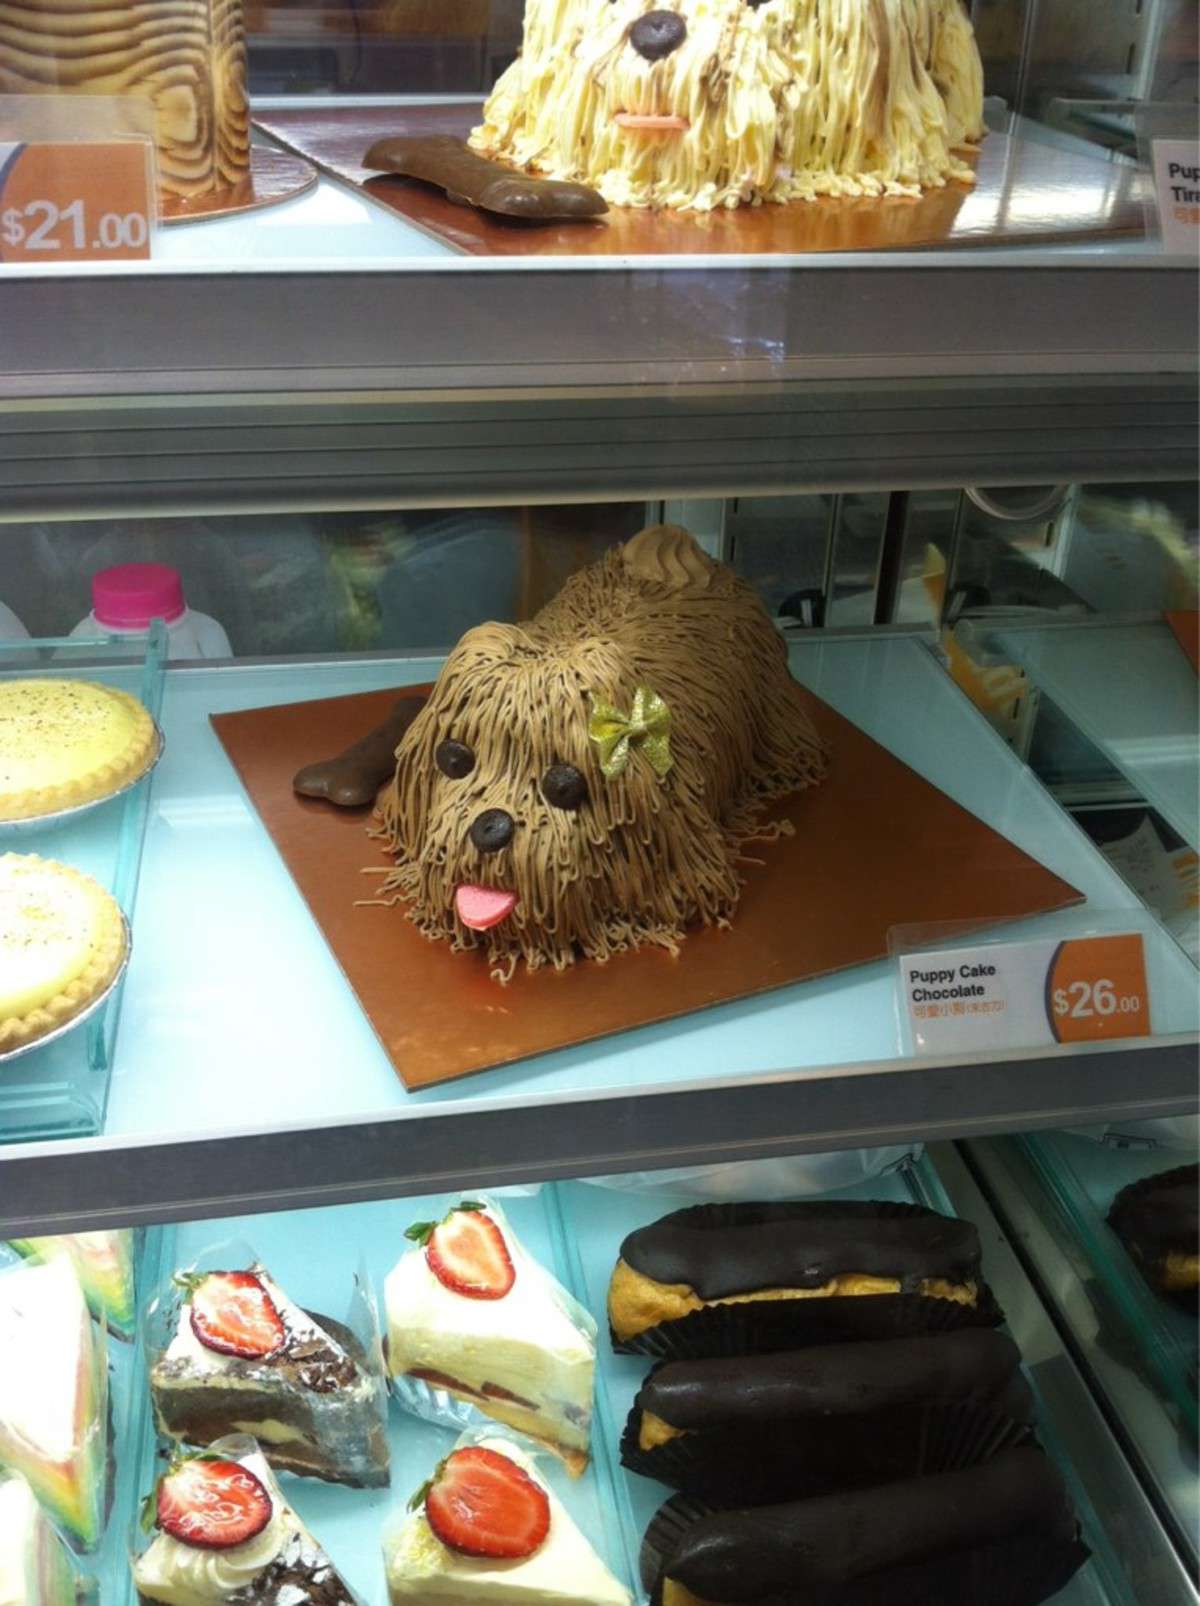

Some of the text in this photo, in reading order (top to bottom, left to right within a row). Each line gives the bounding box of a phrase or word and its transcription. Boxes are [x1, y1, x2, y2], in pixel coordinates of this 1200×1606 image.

[2, 199, 147, 249] $21.00
[909, 963, 997, 985] Puppy Cake
[912, 985, 985, 1002] Chocolate
[1053, 978, 1140, 1019] $26.00
